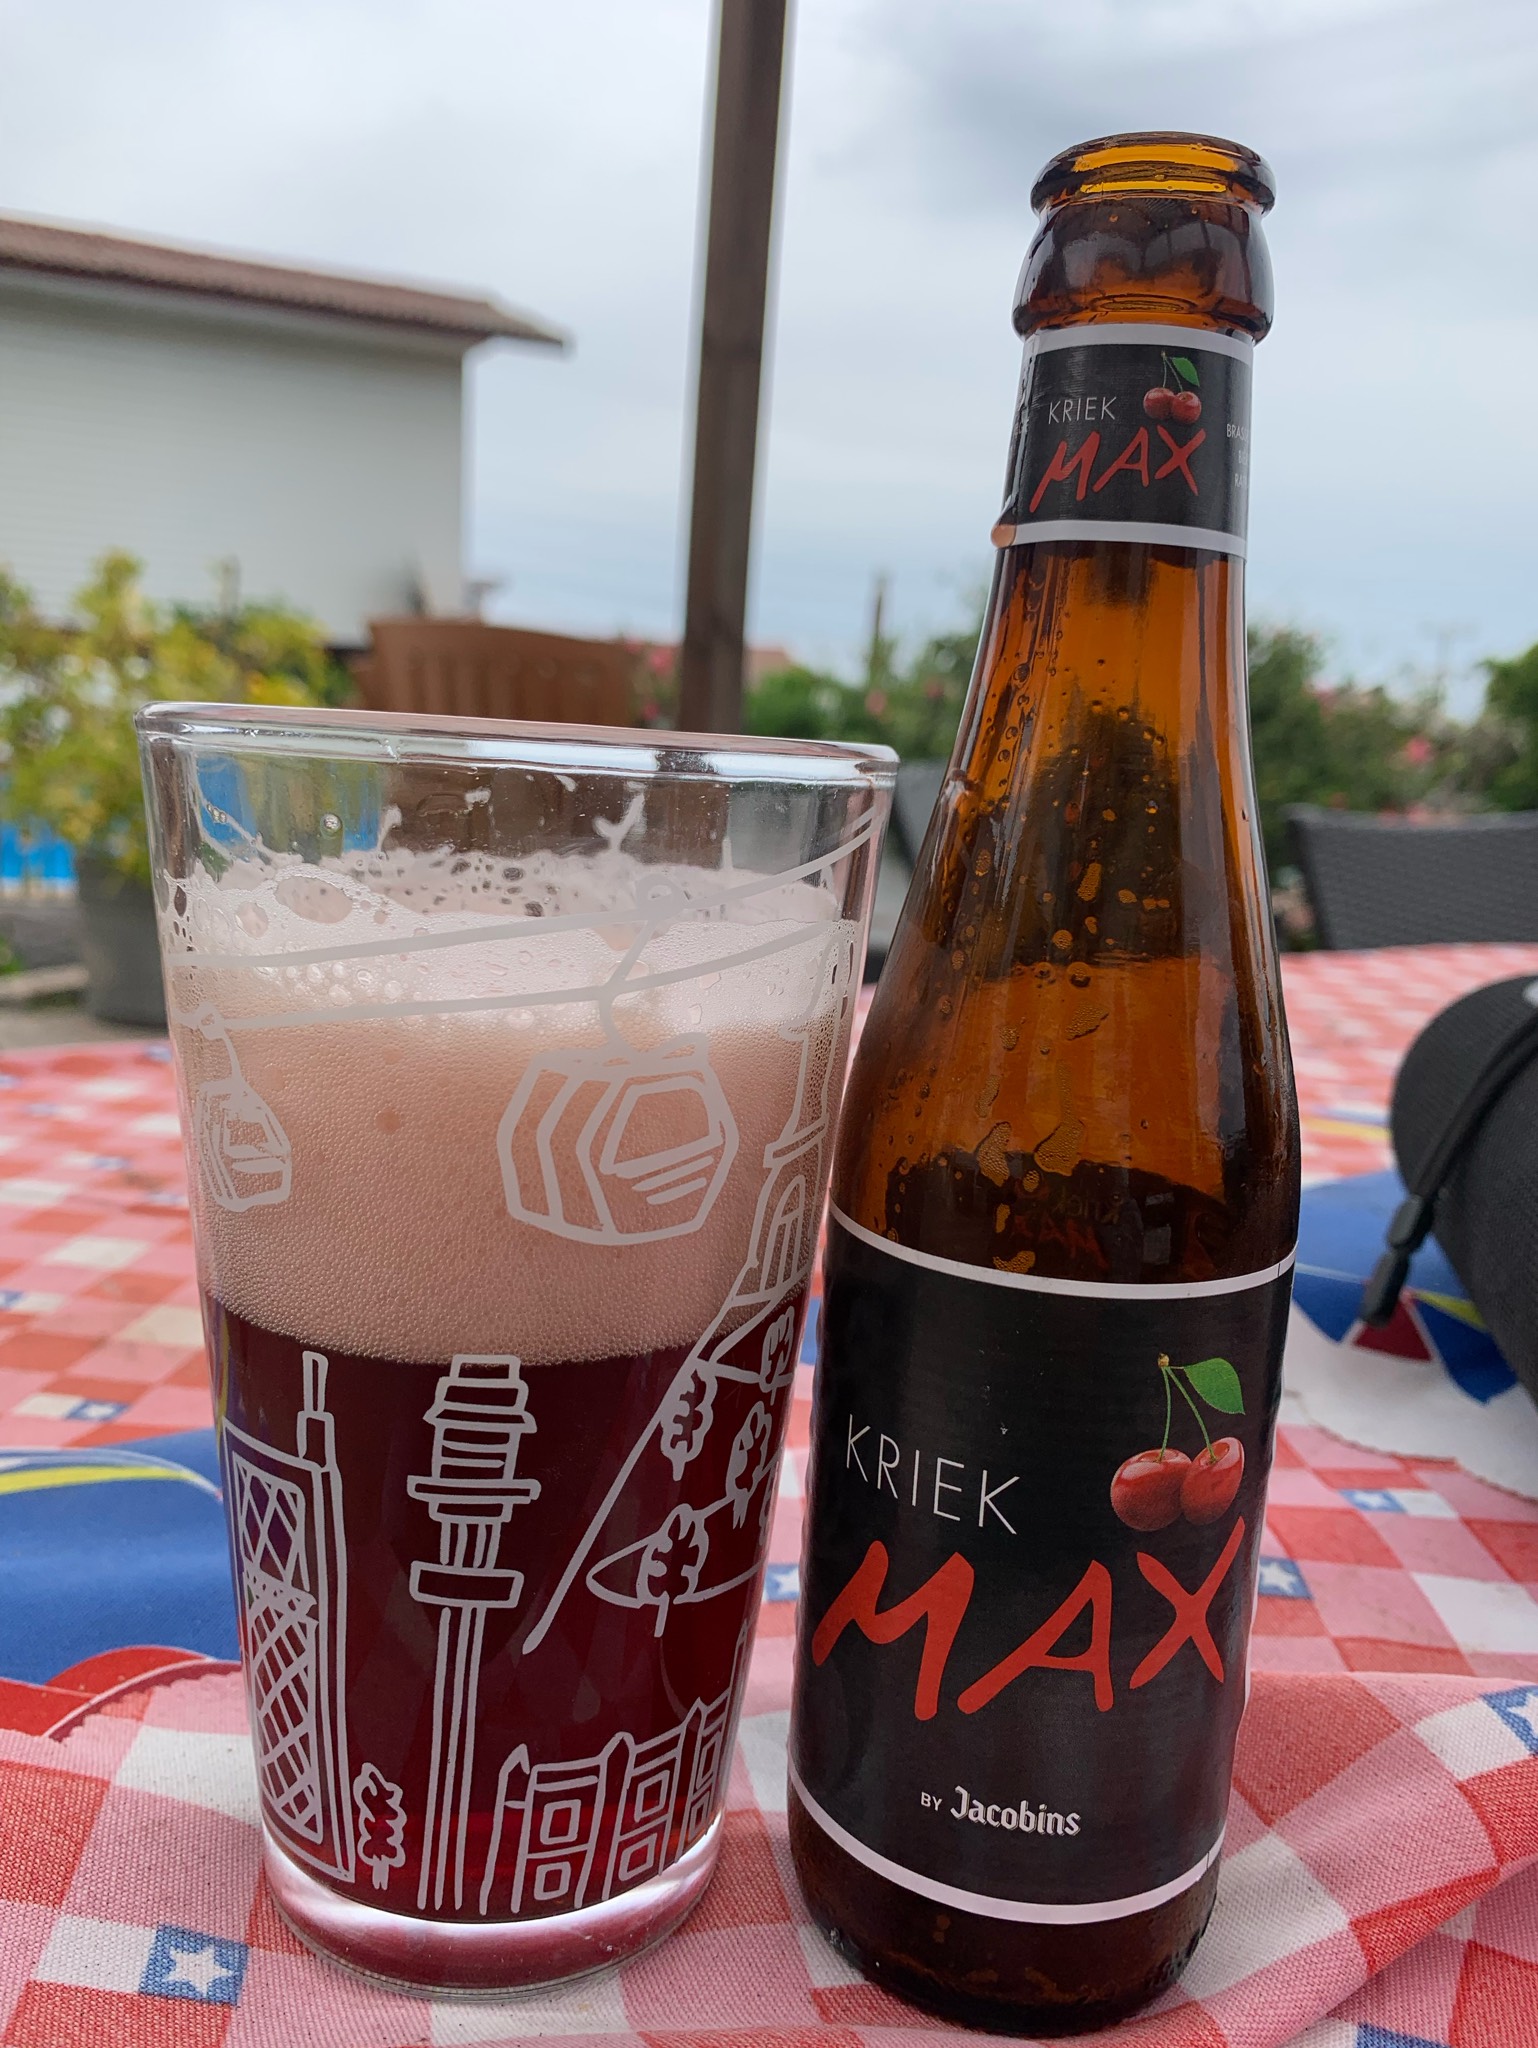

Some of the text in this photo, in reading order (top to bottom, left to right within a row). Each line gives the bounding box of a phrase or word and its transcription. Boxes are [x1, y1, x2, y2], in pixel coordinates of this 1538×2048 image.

[1048, 396, 1117, 425] KRIEK
[1029, 425, 1206, 513] MAX
[846, 1414, 1020, 1535] KRIEK
[811, 1516, 1246, 1721] MAX
[920, 1785, 1081, 1836] BY Jacobins
